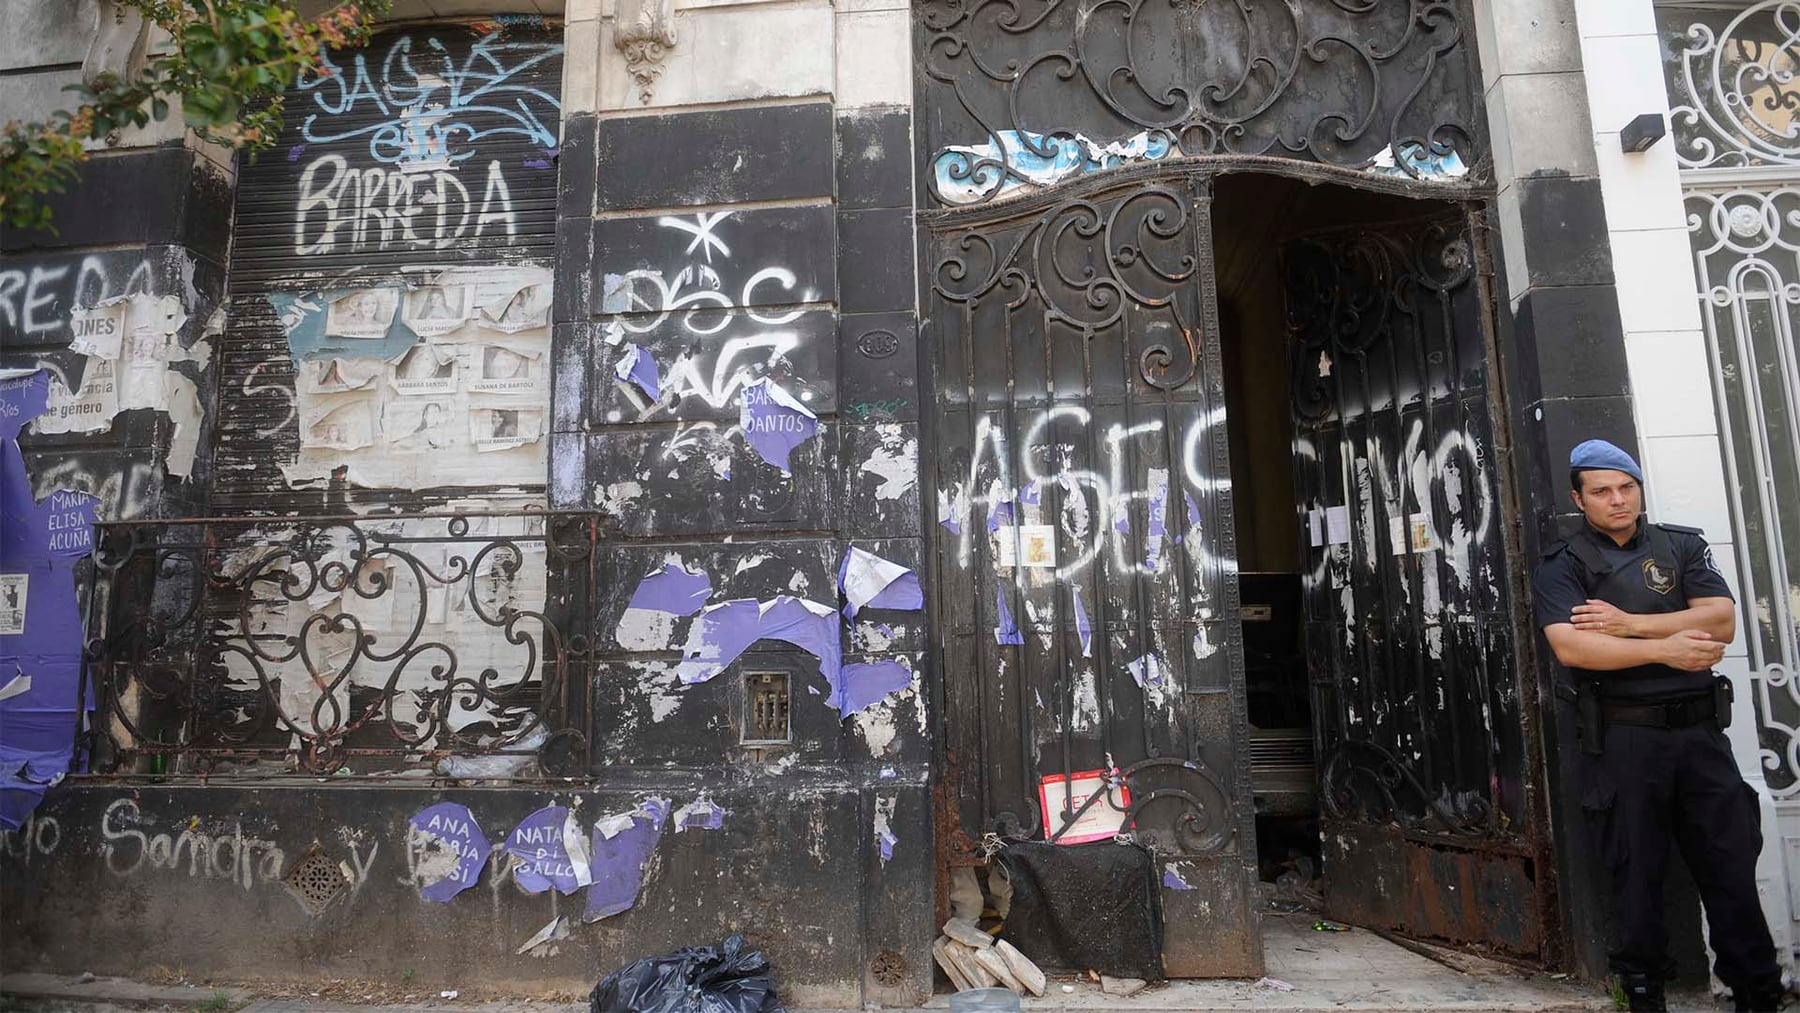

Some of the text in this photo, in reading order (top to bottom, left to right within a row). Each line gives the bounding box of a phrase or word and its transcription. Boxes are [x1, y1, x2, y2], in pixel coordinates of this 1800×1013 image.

[61, 402, 102, 418] género
[48, 511, 85, 531] ELISA
[49, 527, 91, 550] ACUÑA
[428, 814, 470, 839] ANA
